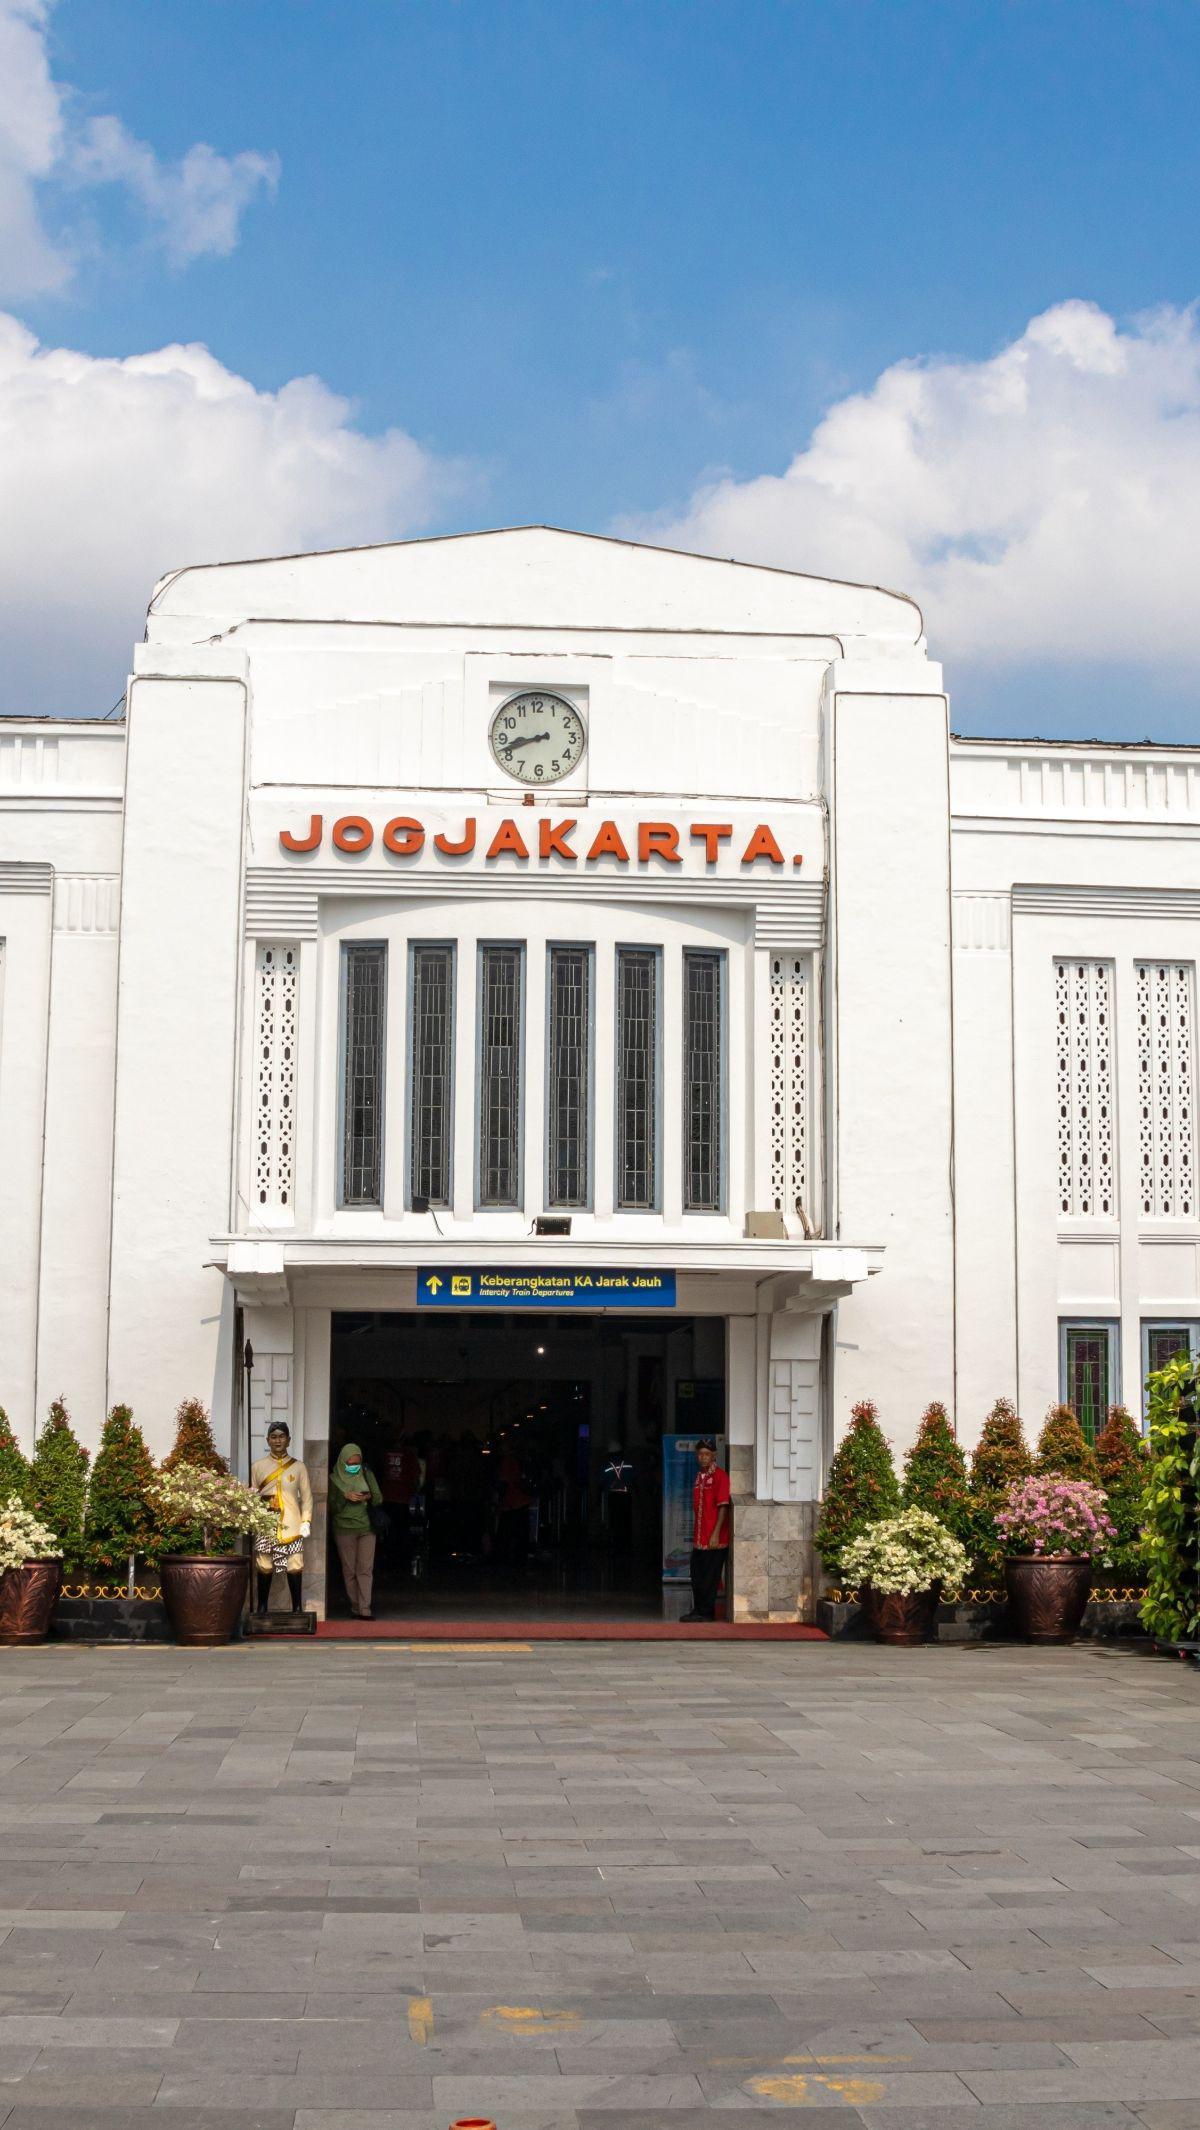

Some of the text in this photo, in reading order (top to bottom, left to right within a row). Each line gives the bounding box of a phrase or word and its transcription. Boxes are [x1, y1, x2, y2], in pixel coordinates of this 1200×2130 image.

[517, 705, 526, 717] 11
[531, 701, 543, 713] 12
[551, 706, 555, 717] 1
[504, 717, 516, 729] 10
[563, 717, 571, 728] 2
[499, 733, 508, 745] 9
[569, 732, 576, 744] 3
[505, 749, 513, 761] 8
[562, 749, 571, 760] 4
[517, 761, 525, 772] 7
[534, 765, 543, 776] 6
[551, 760, 560, 772] 5
[279, 814, 803, 864] JOGJAKARTA.
[480, 1275, 662, 1289] Keberangkatan KA Jarak Jauh
[479, 1289, 510, 1297] Intercity
[532, 1289, 574, 1297] Departures
